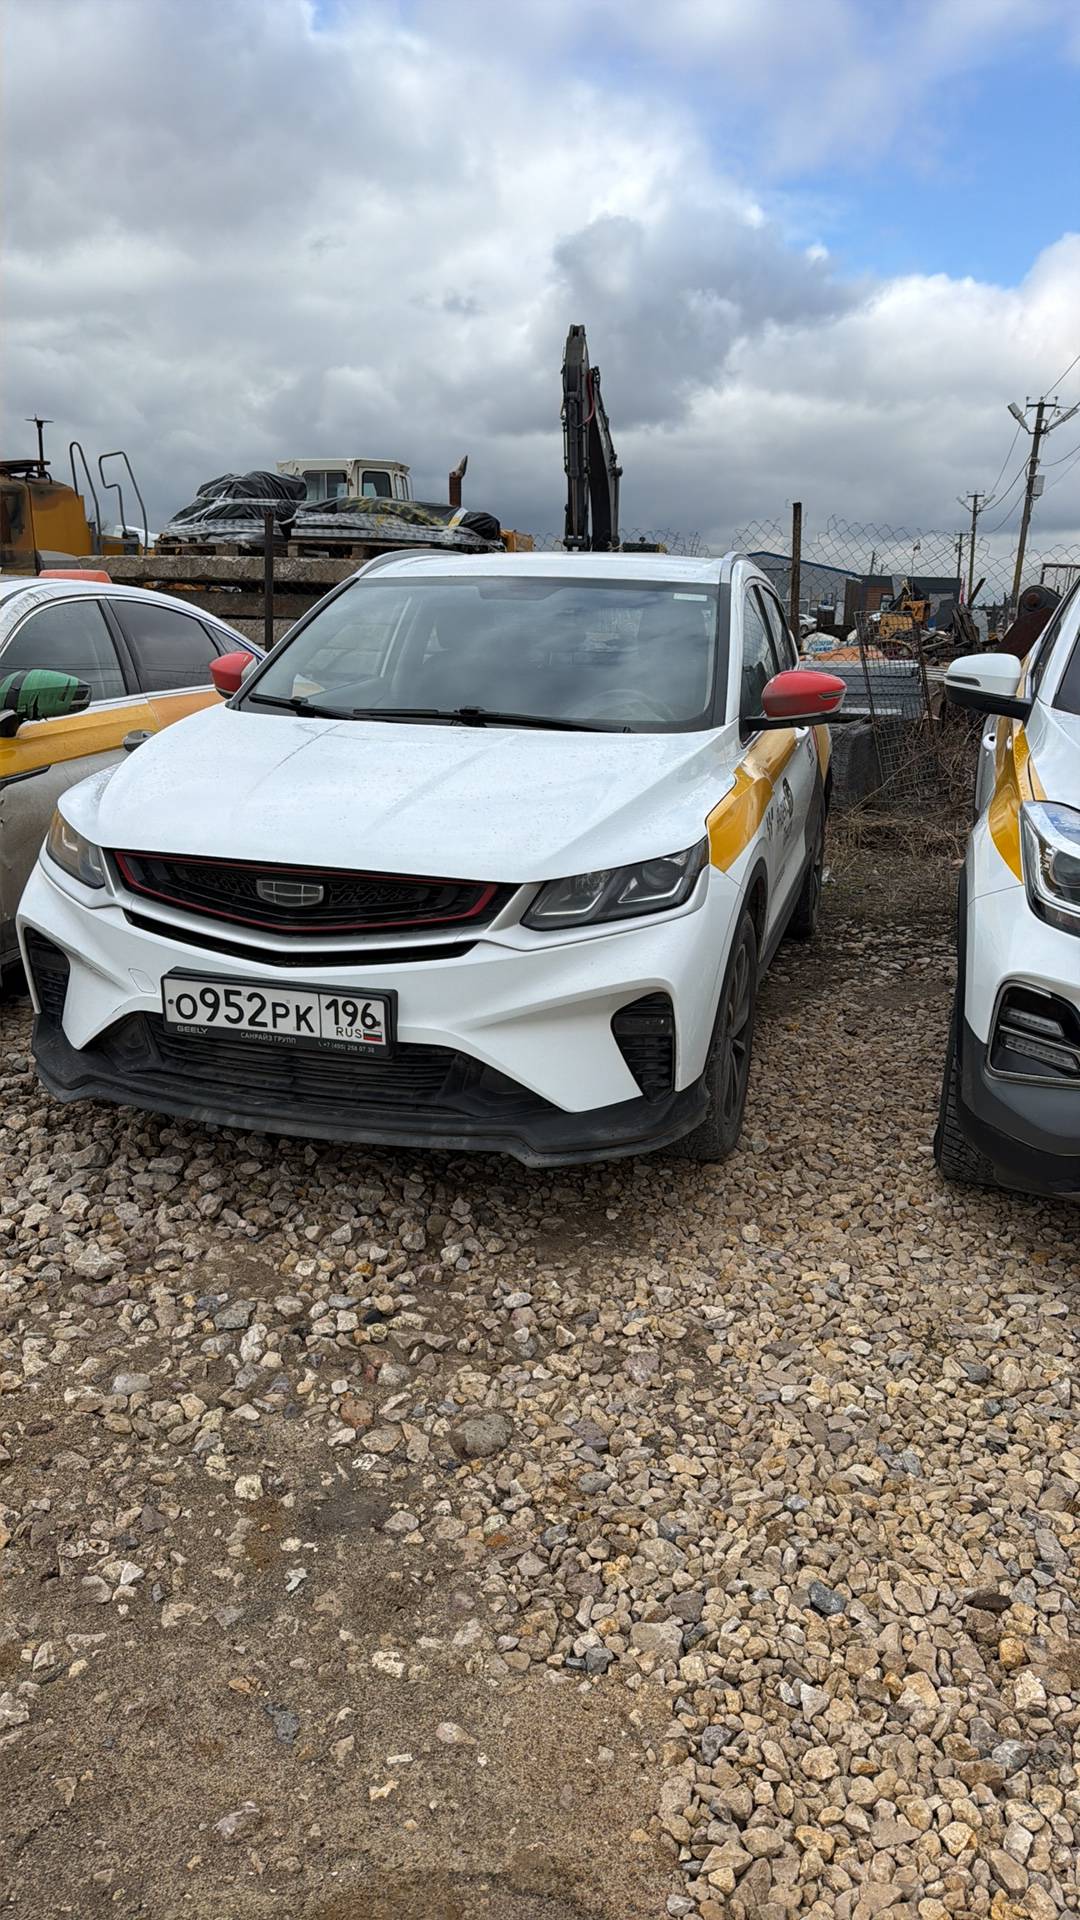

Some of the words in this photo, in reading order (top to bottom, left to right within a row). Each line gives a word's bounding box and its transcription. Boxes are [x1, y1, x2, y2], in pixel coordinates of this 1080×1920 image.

[325, 998, 378, 1029] 196
[176, 1025, 209, 1034] GEELY
[336, 1027, 362, 1039] RUS
